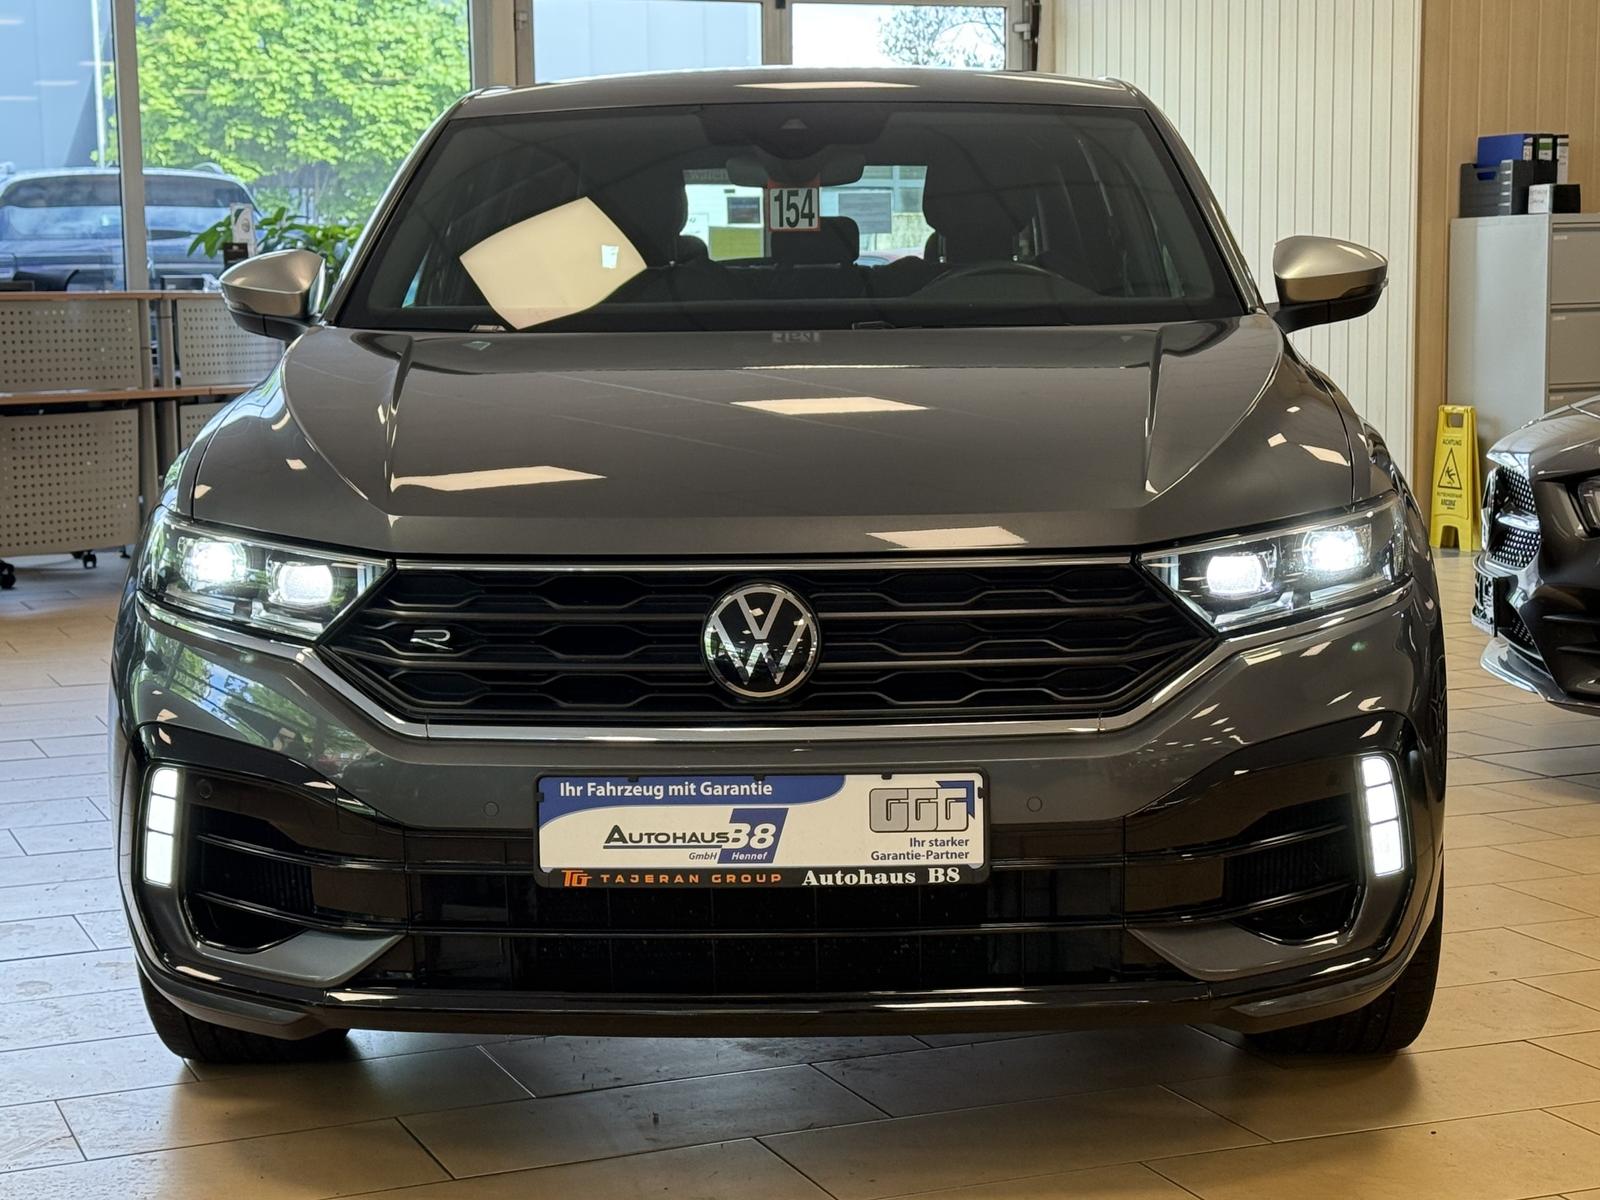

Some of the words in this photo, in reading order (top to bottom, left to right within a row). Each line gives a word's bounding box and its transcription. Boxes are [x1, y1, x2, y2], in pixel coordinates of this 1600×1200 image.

[774, 188, 815, 229] 154
[410, 629, 453, 650] R
[560, 782, 583, 797] Ihr
[587, 782, 664, 800] Fahrzeug
[668, 781, 697, 796] mit
[700, 781, 773, 796] Garantie
[909, 837, 926, 848] Ihr
[928, 836, 970, 848] starker
[688, 852, 718, 861] GmbH
[731, 851, 768, 861] Hennef
[871, 850, 970, 861] Garantie-Partner
[600, 874, 699, 884] TAJERAN
[711, 873, 782, 884] GROUP
[801, 869, 916, 887] Autohaus
[927, 867, 961, 884] B8
